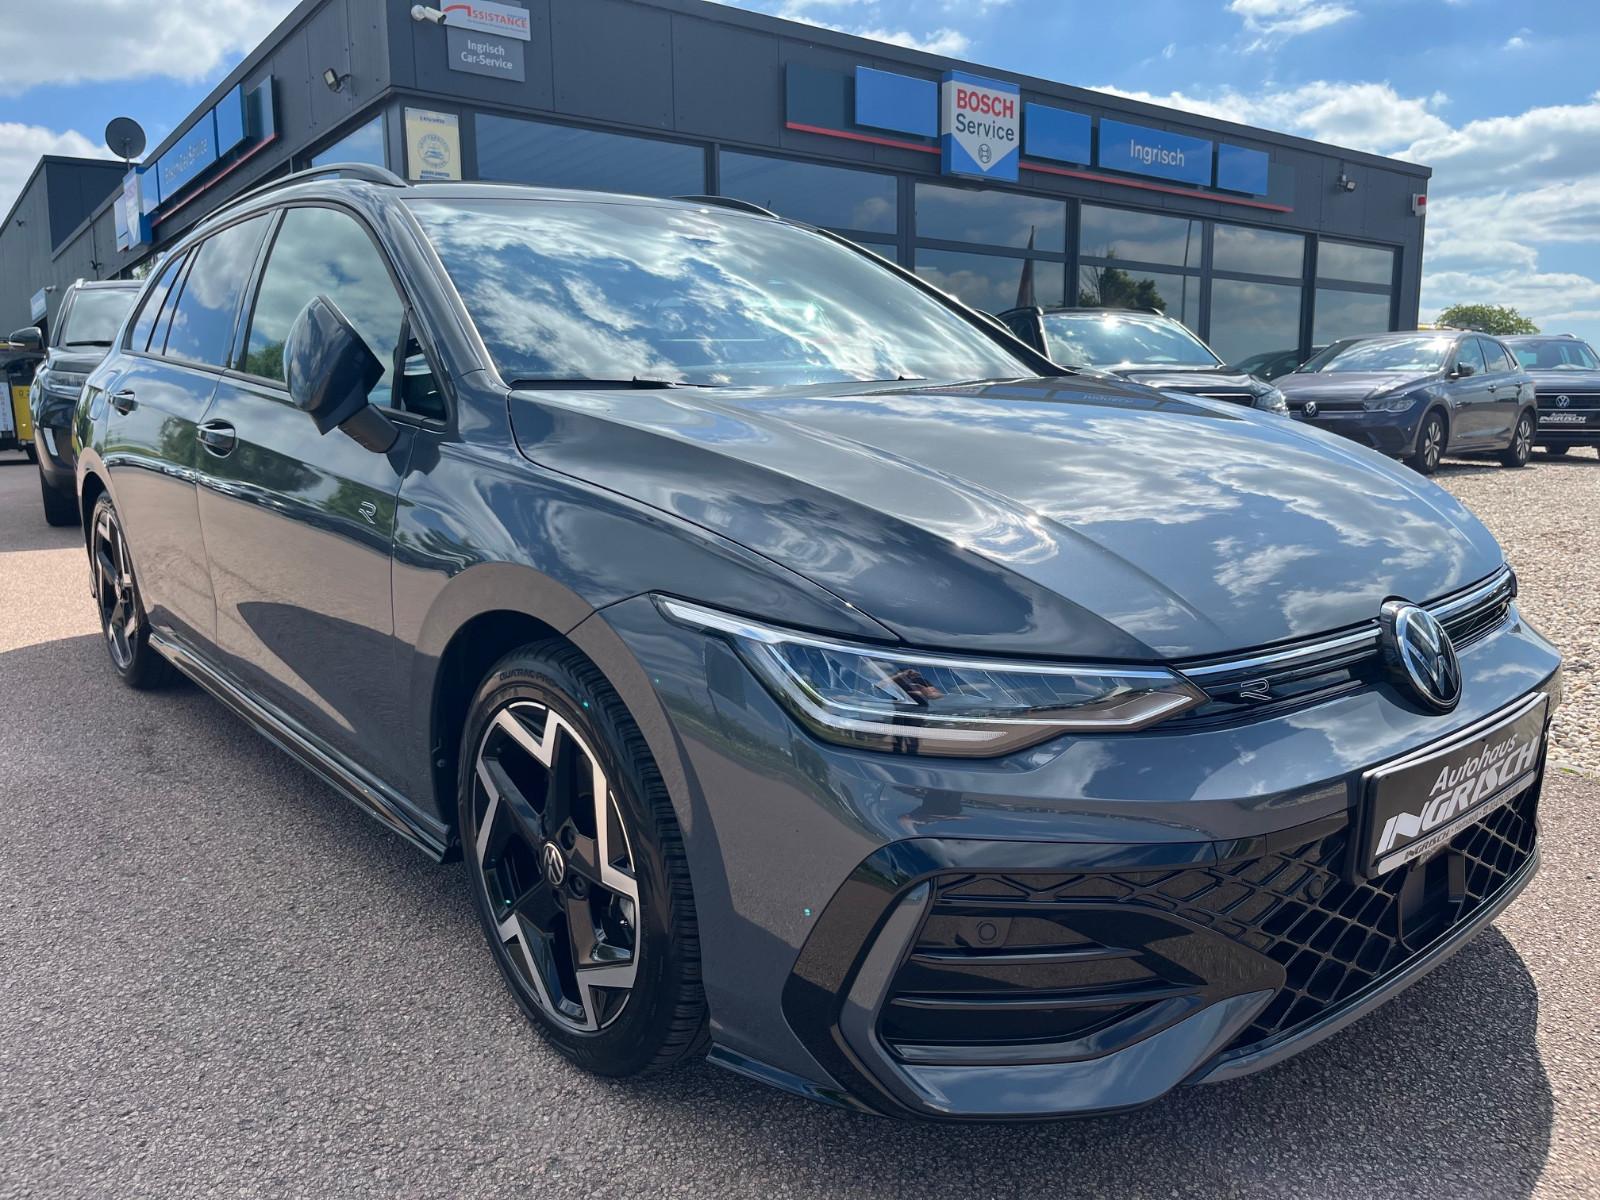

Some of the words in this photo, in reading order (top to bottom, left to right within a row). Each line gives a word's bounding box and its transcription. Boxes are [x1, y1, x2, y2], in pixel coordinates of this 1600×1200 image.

[460, 51, 513, 69] Car-Service
[467, 39, 505, 56] Ingrisch
[957, 88, 1014, 119] BOSCH
[955, 113, 1015, 142] Service
[1130, 138, 1185, 168] Ingrisch
[1429, 733, 1518, 797] Autohaus
